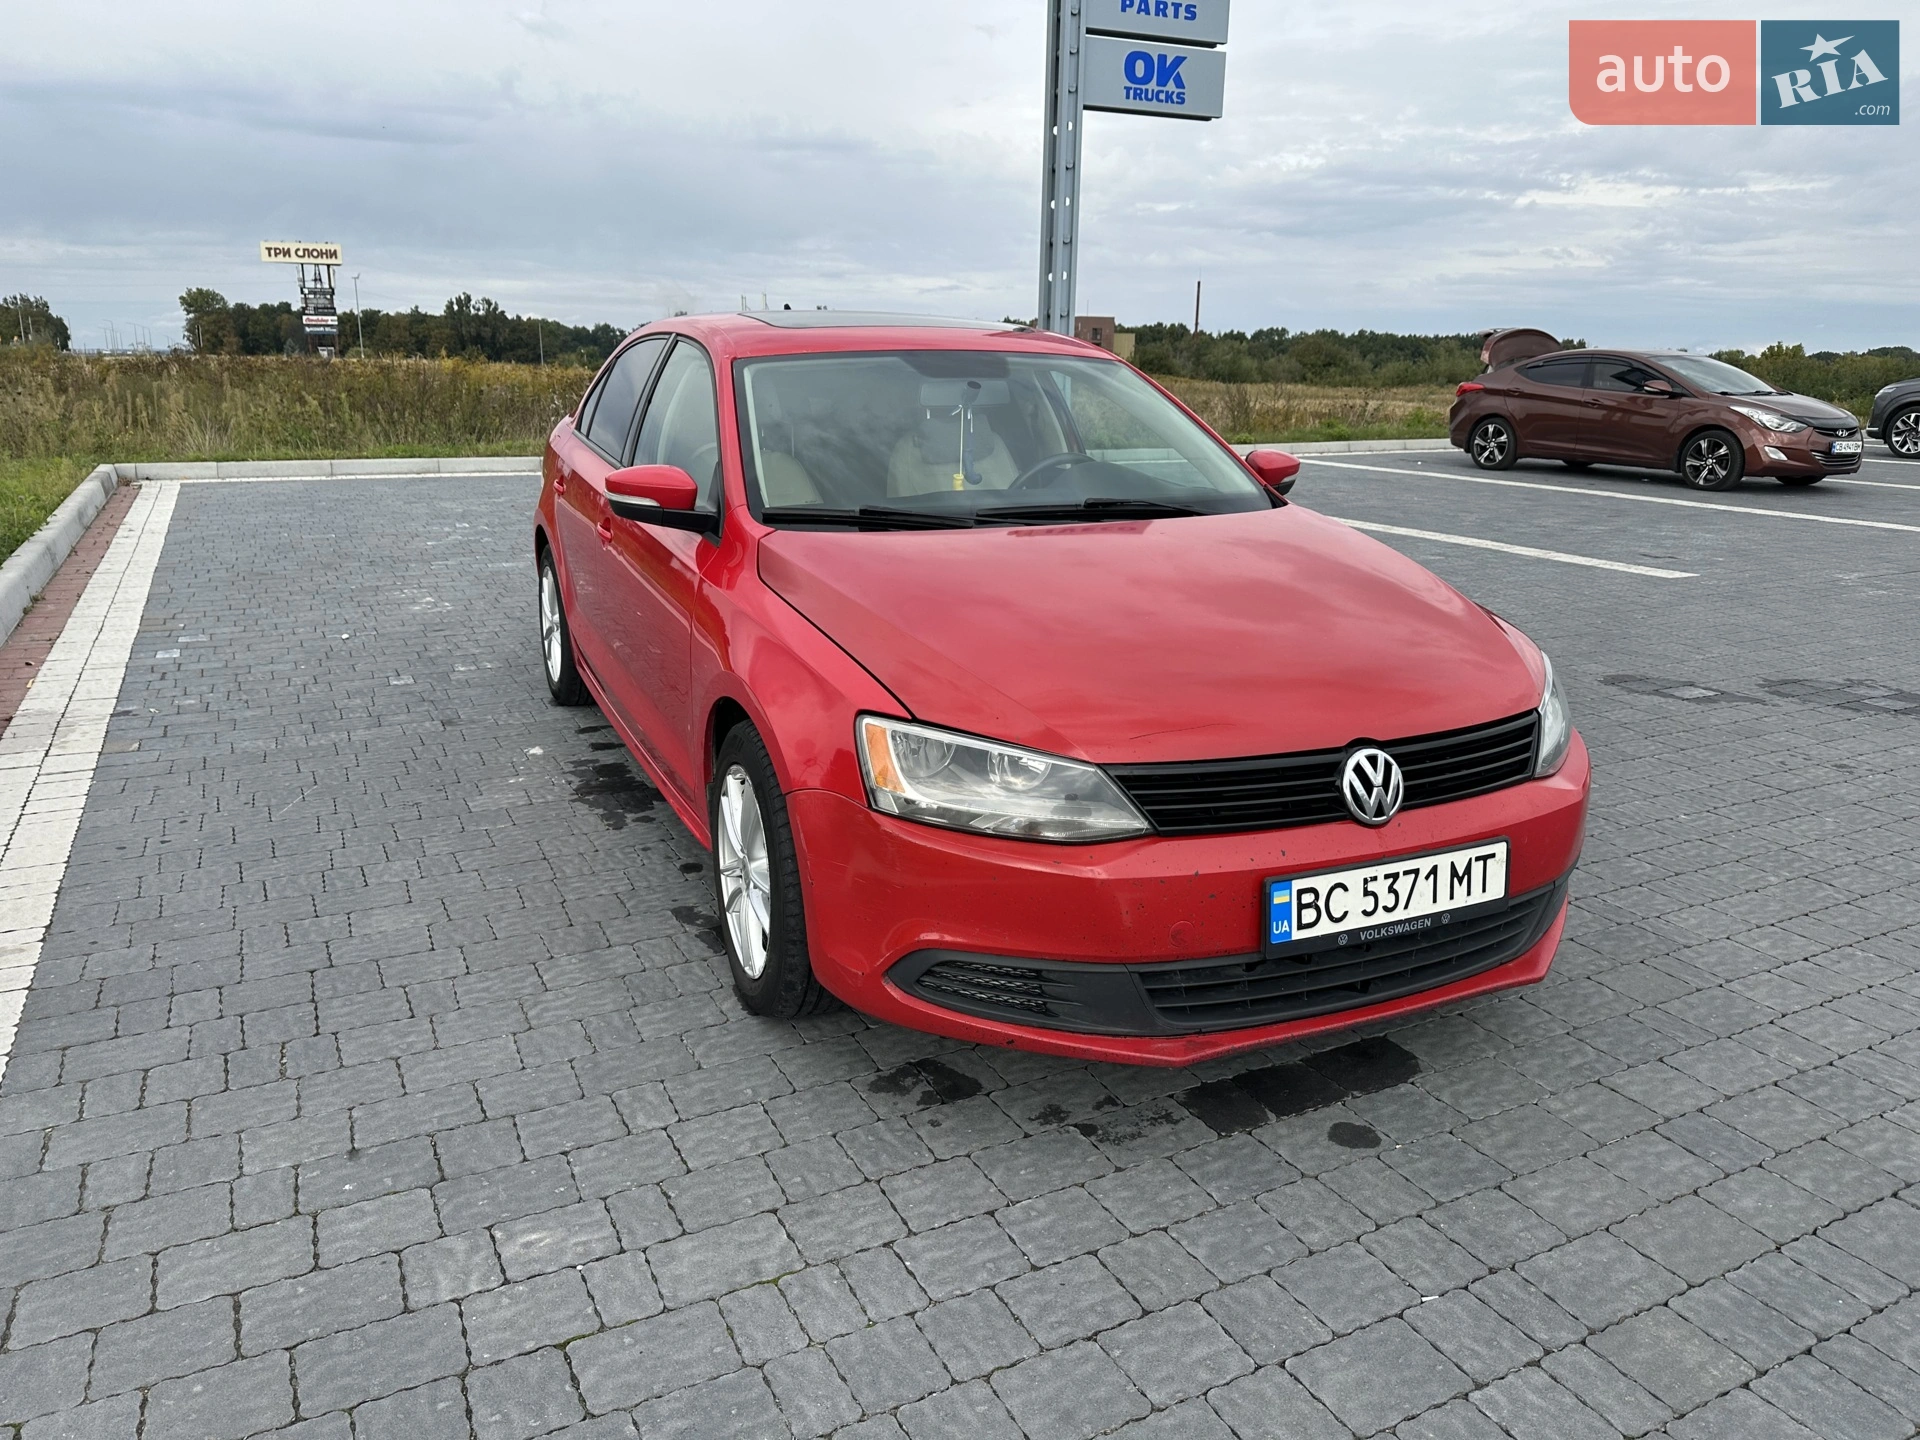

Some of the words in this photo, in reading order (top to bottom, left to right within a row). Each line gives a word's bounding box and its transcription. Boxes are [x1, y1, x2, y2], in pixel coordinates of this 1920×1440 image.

[1121, 0, 1197, 21] PARTS
[1124, 50, 1188, 89] OK
[1123, 86, 1185, 105] TRUCKS
[265, 247, 291, 258] ТРИ
[294, 248, 338, 260] СЛОНИ
[1296, 882, 1349, 931] BC
[1361, 864, 1439, 917] 5371
[1449, 852, 1496, 901] MT
[1273, 920, 1290, 934] UA
[1360, 917, 1432, 941] VOLKSWAGEN
